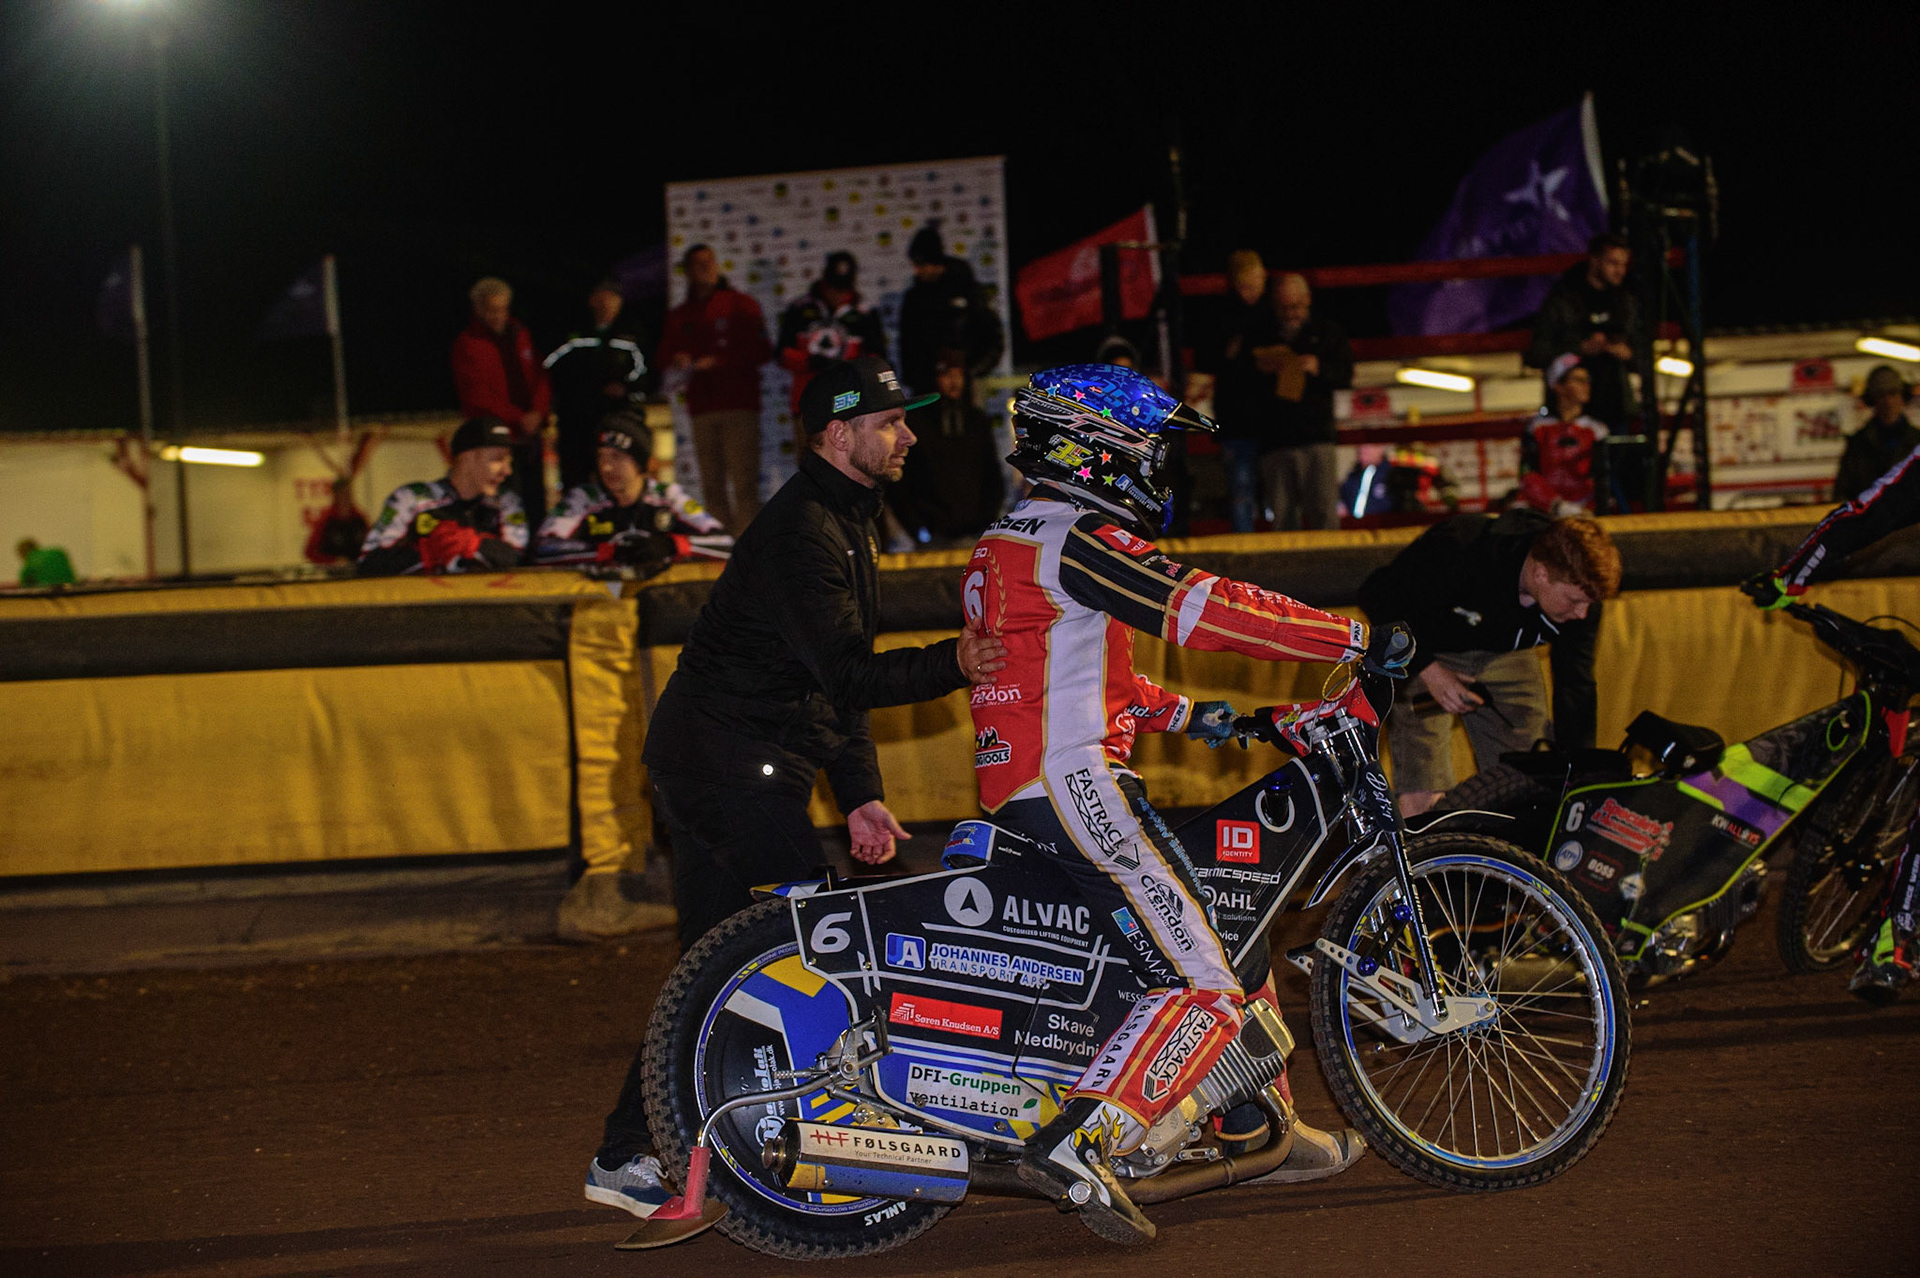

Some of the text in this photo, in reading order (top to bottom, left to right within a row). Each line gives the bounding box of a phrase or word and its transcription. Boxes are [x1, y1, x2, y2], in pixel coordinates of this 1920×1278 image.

[1076, 768, 1129, 850] FASTRACK
[1565, 802, 1585, 832] 6
[1223, 826, 1253, 849] ID
[1587, 858, 1616, 879] BOSS
[1002, 895, 1091, 935] ALVAC
[1140, 874, 1193, 952] Crendon
[811, 911, 853, 954] 6
[1003, 925, 1089, 948] CUSTOMIZED LIFTING EQUIPMENT
[931, 957, 1015, 981] TRANSPORT
[932, 945, 1082, 983] JOHANNES ANDERSEN
[915, 1013, 999, 1036] Søren Knudsen A/S
[1048, 1013, 1095, 1037] Skave
[1160, 1012, 1214, 1085] FASTRACK
[911, 1066, 1021, 1096] DFI-Gruppen
[909, 1090, 1019, 1118] ventilation
[854, 1137, 961, 1158] FØLSGAARD
[854, 1150, 932, 1164] Your Technical Partner
[864, 1201, 907, 1226] ANLAS
